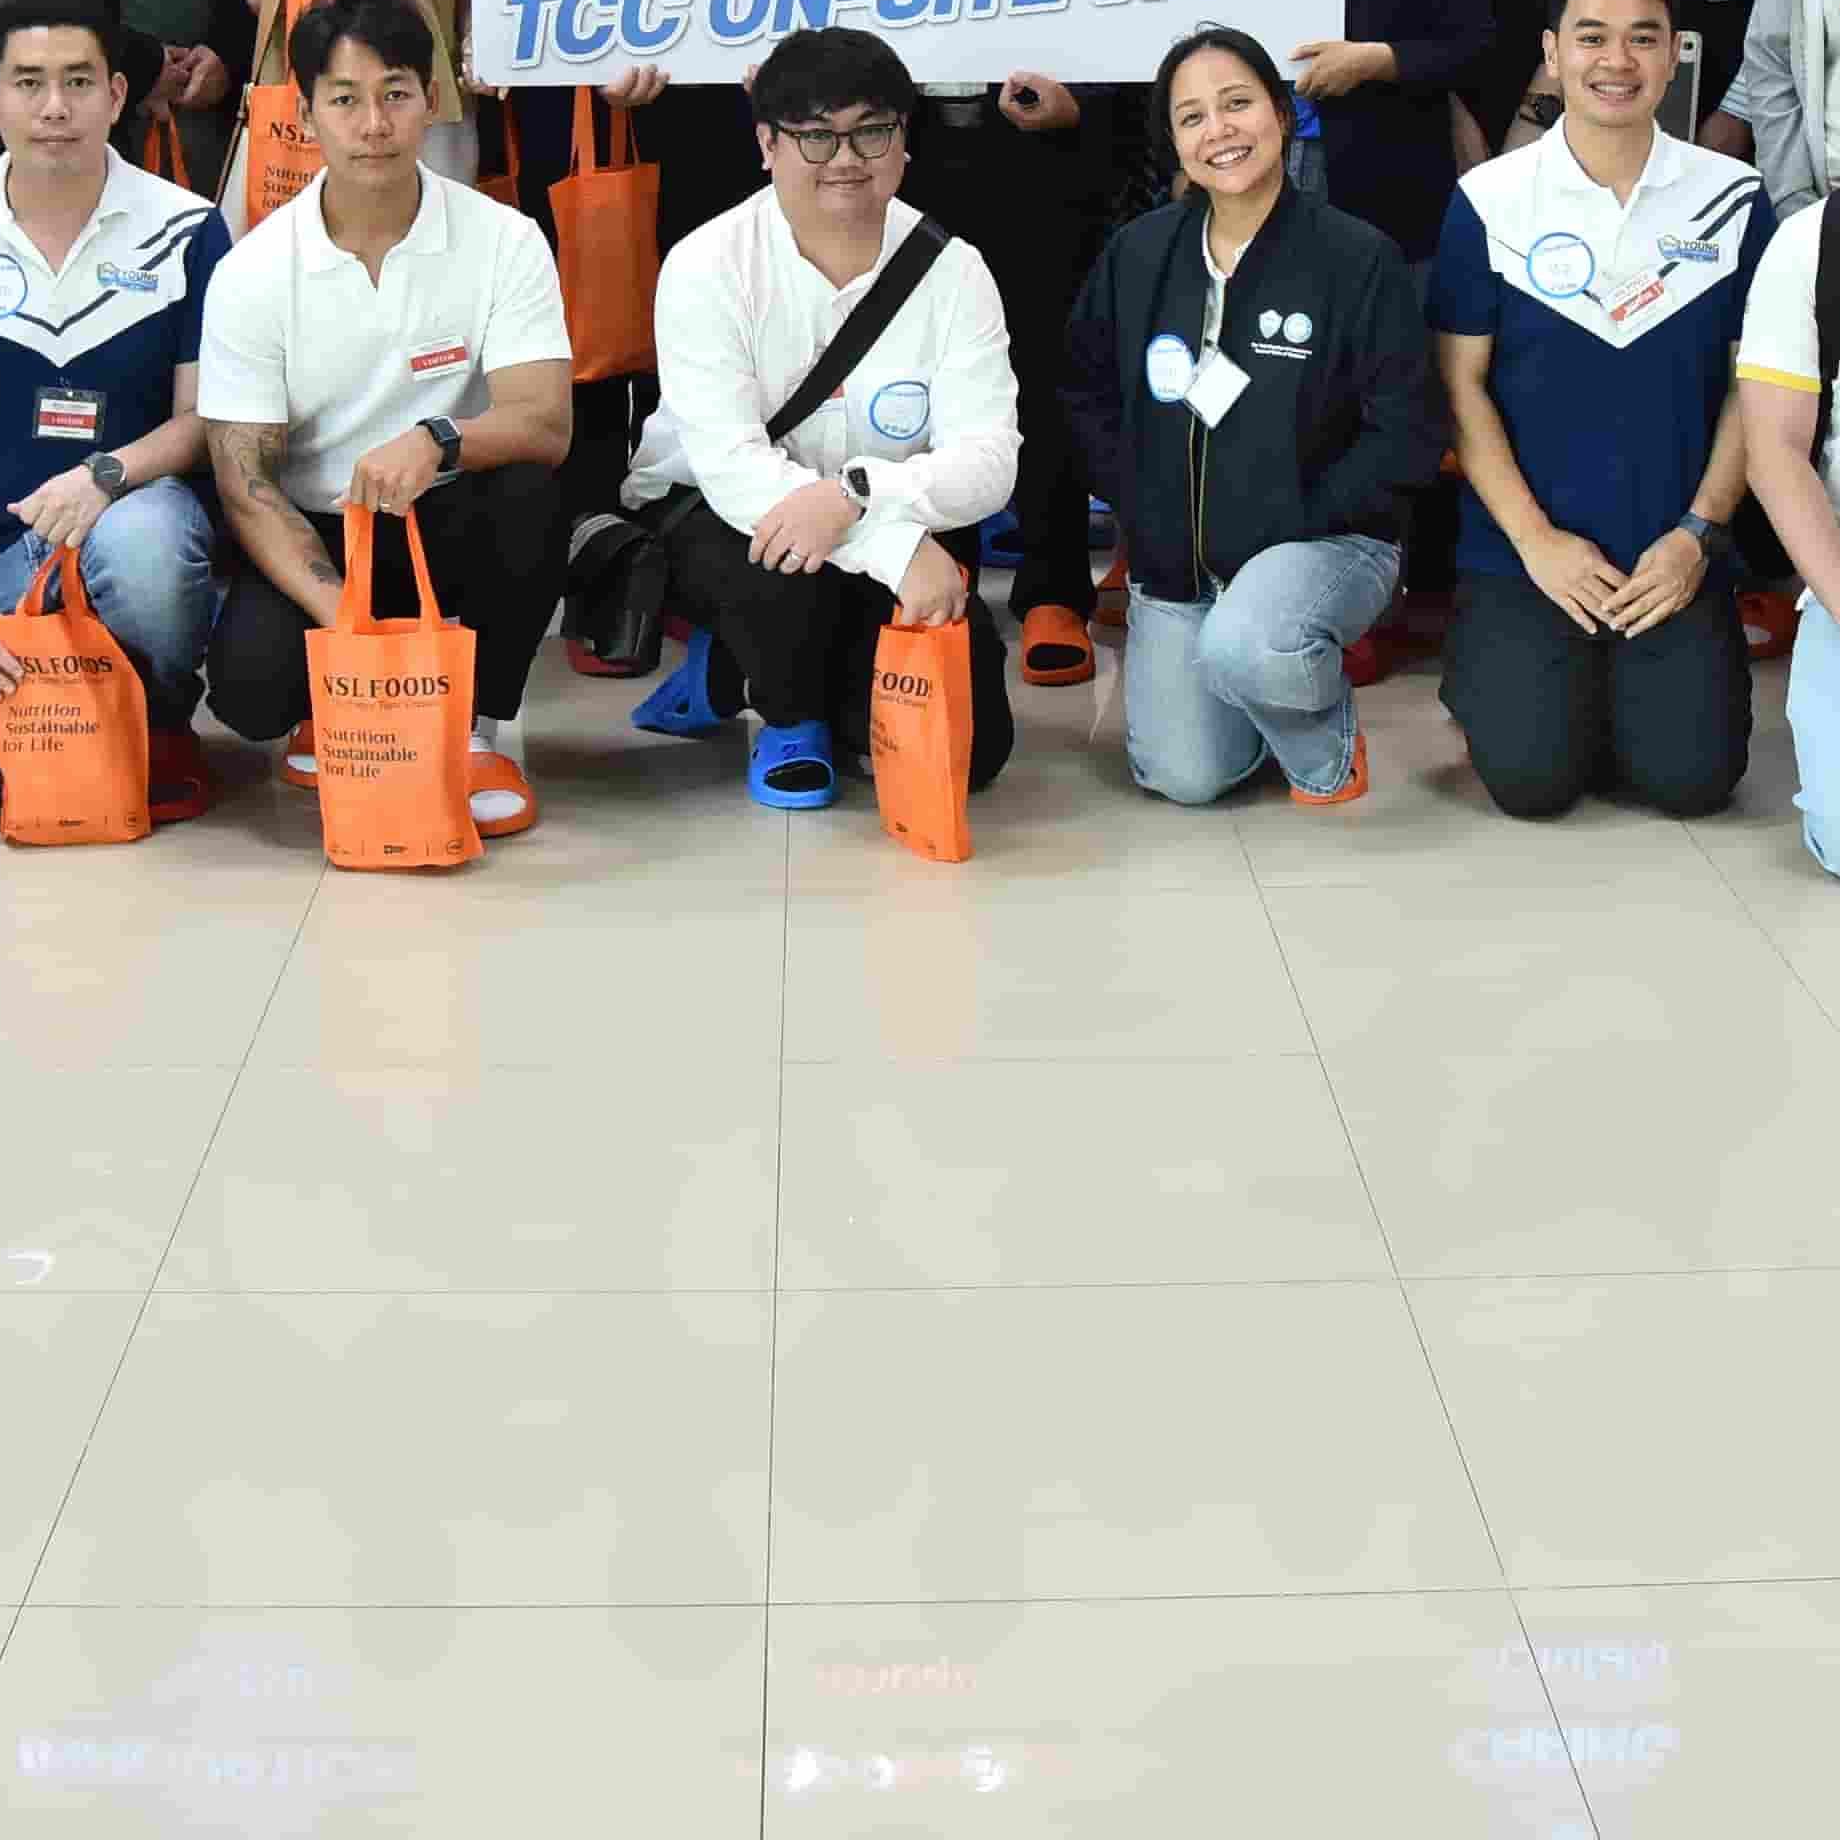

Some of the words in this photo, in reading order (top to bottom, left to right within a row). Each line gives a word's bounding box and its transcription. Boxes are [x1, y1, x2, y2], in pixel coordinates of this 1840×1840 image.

[369, 674, 450, 698] FOODS
[874, 669, 933, 698] OOD
[8, 703, 81, 718] Nutrition
[31, 737, 64, 752] Life
[322, 727, 397, 745] Nutrition
[322, 743, 418, 762] Sustainable
[351, 763, 382, 779] Life
